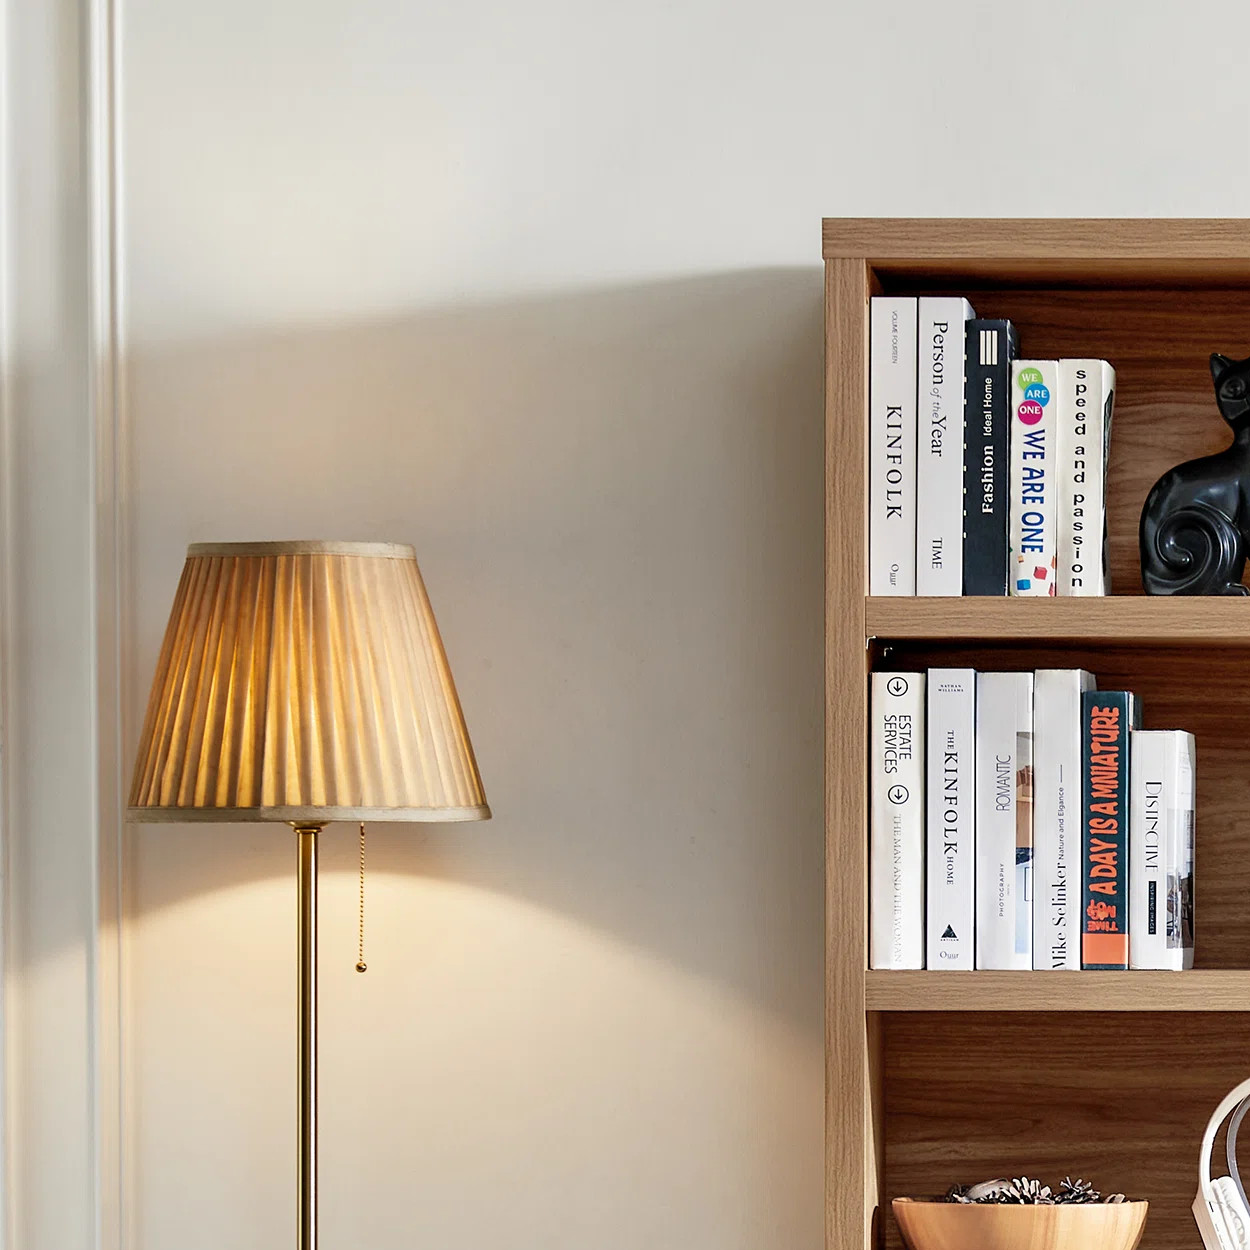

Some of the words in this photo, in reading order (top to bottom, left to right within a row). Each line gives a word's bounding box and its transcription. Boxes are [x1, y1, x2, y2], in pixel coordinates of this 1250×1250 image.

[933, 321, 948, 385] Person
[930, 387, 941, 398] of
[983, 378, 992, 407] Home
[1021, 373, 1038, 382] WE
[1026, 389, 1047, 398] ARE
[932, 402, 941, 418] the
[1020, 406, 1041, 414] ONE
[1074, 369, 1087, 435] speed
[931, 415, 947, 457] Year
[983, 411, 992, 436] Ideal
[886, 405, 902, 519] KINFOLK
[1022, 429, 1046, 460] WE
[981, 445, 994, 514] Fashion
[1074, 446, 1085, 483] and
[1022, 467, 1045, 505] ARE
[1021, 511, 1044, 553] ONE
[1071, 494, 1085, 587] passion
[932, 537, 942, 569] TIME
[884, 715, 897, 774] SERVICES
[898, 715, 911, 760] ESTATE
[1090, 705, 1120, 798] MNIATURE
[995, 755, 1011, 811] ROMANTIC
[944, 752, 958, 855] KINFOLK
[1090, 801, 1118, 816] A
[893, 813, 901, 836] THE
[1089, 818, 1118, 835] IS
[893, 838, 901, 864] MAN
[1089, 838, 1118, 878] DAY
[893, 866, 901, 891] AND
[1052, 862, 1066, 926] Selinker
[1089, 881, 1117, 895] A
[893, 893, 901, 915] THE
[893, 917, 901, 962] WOMAN
